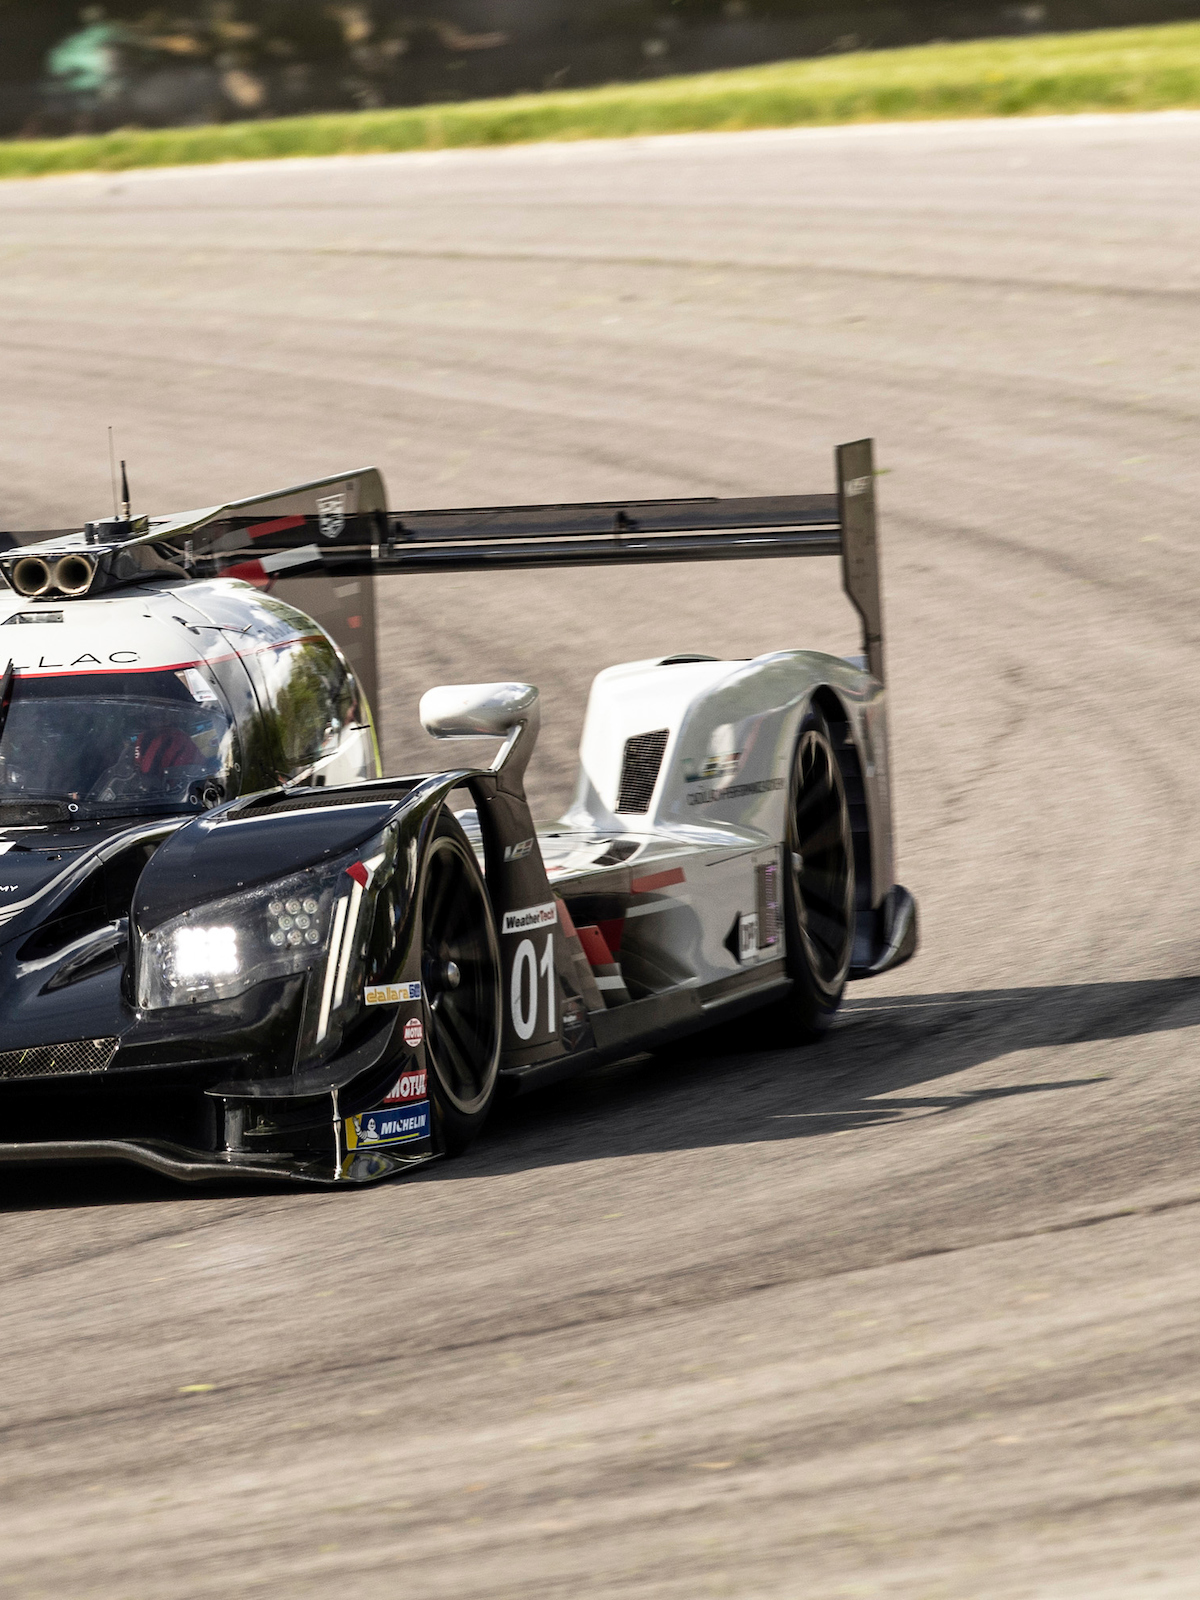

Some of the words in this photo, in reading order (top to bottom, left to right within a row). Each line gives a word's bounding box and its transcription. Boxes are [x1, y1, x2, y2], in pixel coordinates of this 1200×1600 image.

[506, 908, 555, 929] WeatherTech
[511, 933, 556, 1040] 01
[386, 1073, 427, 1099] MOTUL
[380, 1114, 427, 1135] MICHELIN
